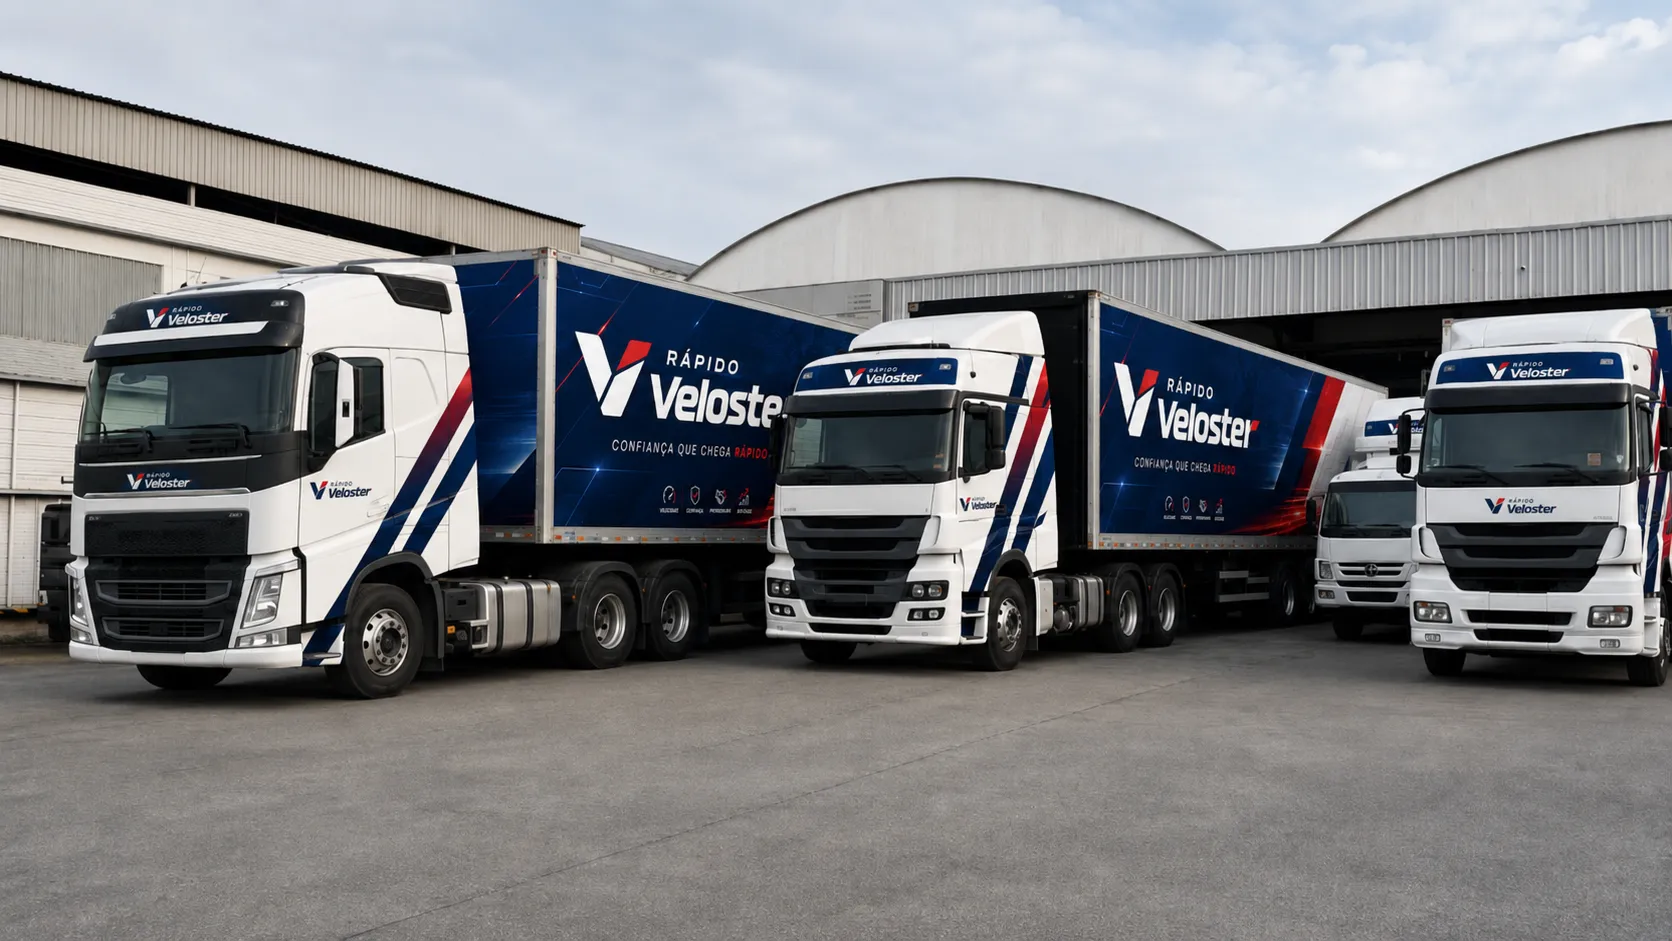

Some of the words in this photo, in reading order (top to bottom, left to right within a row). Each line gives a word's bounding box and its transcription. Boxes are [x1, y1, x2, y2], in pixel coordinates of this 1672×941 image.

[168, 312, 230, 326] Veloster
[666, 348, 739, 375] RÁPIDO
[866, 372, 923, 384] Veloster
[1510, 366, 1571, 379] Veloster
[1167, 376, 1214, 399] RÁPIDO
[650, 372, 783, 429] Veloste
[1157, 397, 1260, 449] Veloster
[611, 439, 674, 457] CONFIANÇA
[677, 443, 697, 456] QUE
[700, 445, 731, 458] CHEGA
[734, 444, 768, 460] RÁPIDO
[1134, 456, 1173, 472] CONFIANÇA
[1175, 461, 1188, 471] QUE
[144, 478, 192, 489] Veloster
[328, 486, 372, 499] Veloster
[1507, 503, 1557, 514] Veloster
